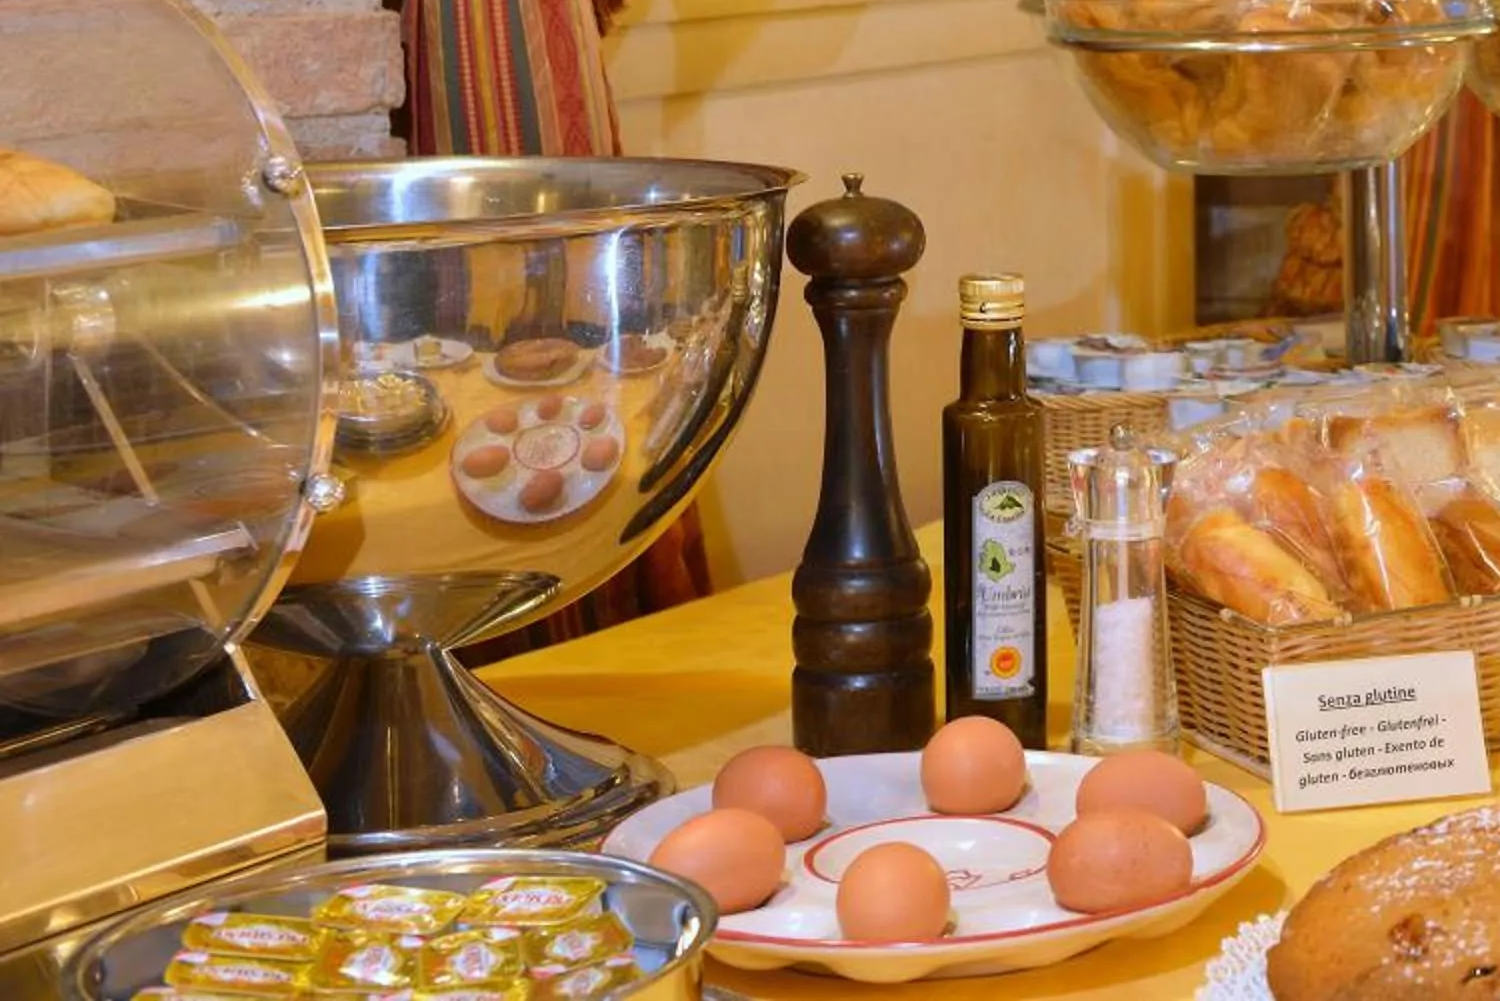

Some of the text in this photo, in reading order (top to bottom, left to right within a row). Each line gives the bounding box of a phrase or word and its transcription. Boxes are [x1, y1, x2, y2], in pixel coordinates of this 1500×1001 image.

[1318, 687, 1416, 710] Senza glutine
[1377, 714, 1439, 732] Glutenfrei
[1303, 752, 1332, 764] Sans
[1335, 746, 1375, 762] gluten
[1385, 740, 1427, 754] Exento
[1429, 736, 1445, 748] de
[1299, 772, 1339, 789] gluten
